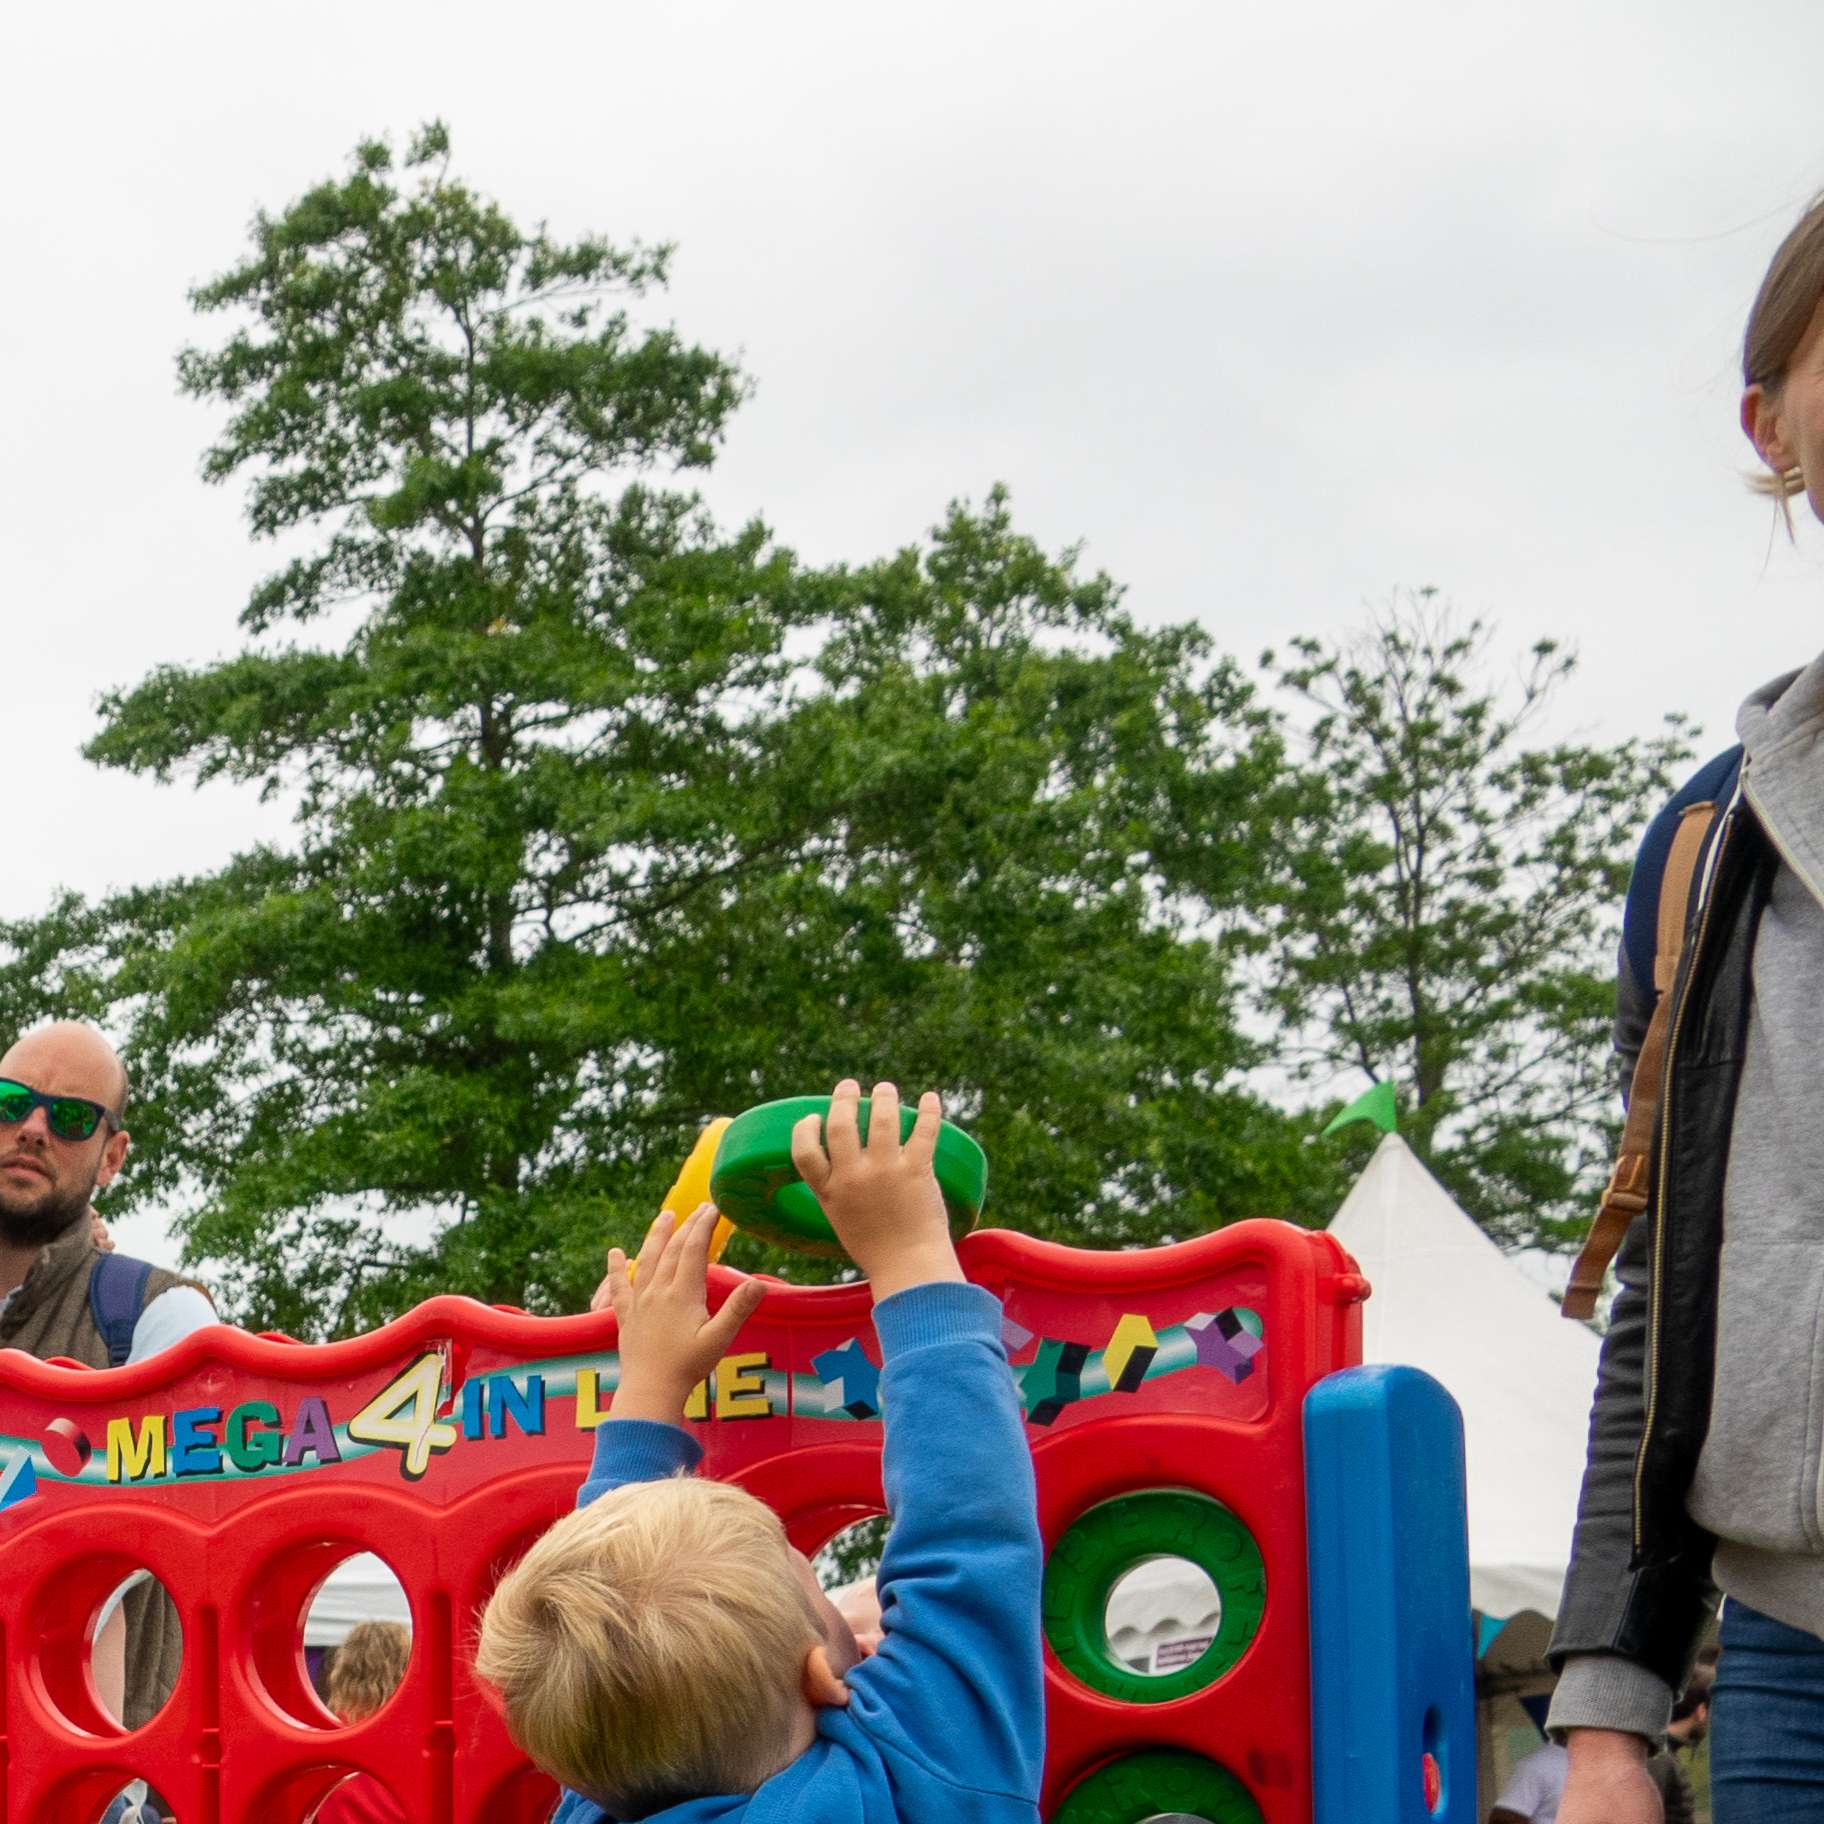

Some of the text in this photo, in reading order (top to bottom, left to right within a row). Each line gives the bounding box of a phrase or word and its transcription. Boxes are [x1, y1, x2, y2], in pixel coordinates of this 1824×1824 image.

[106, 1351, 773, 1483] MEGA 4 IN LE
